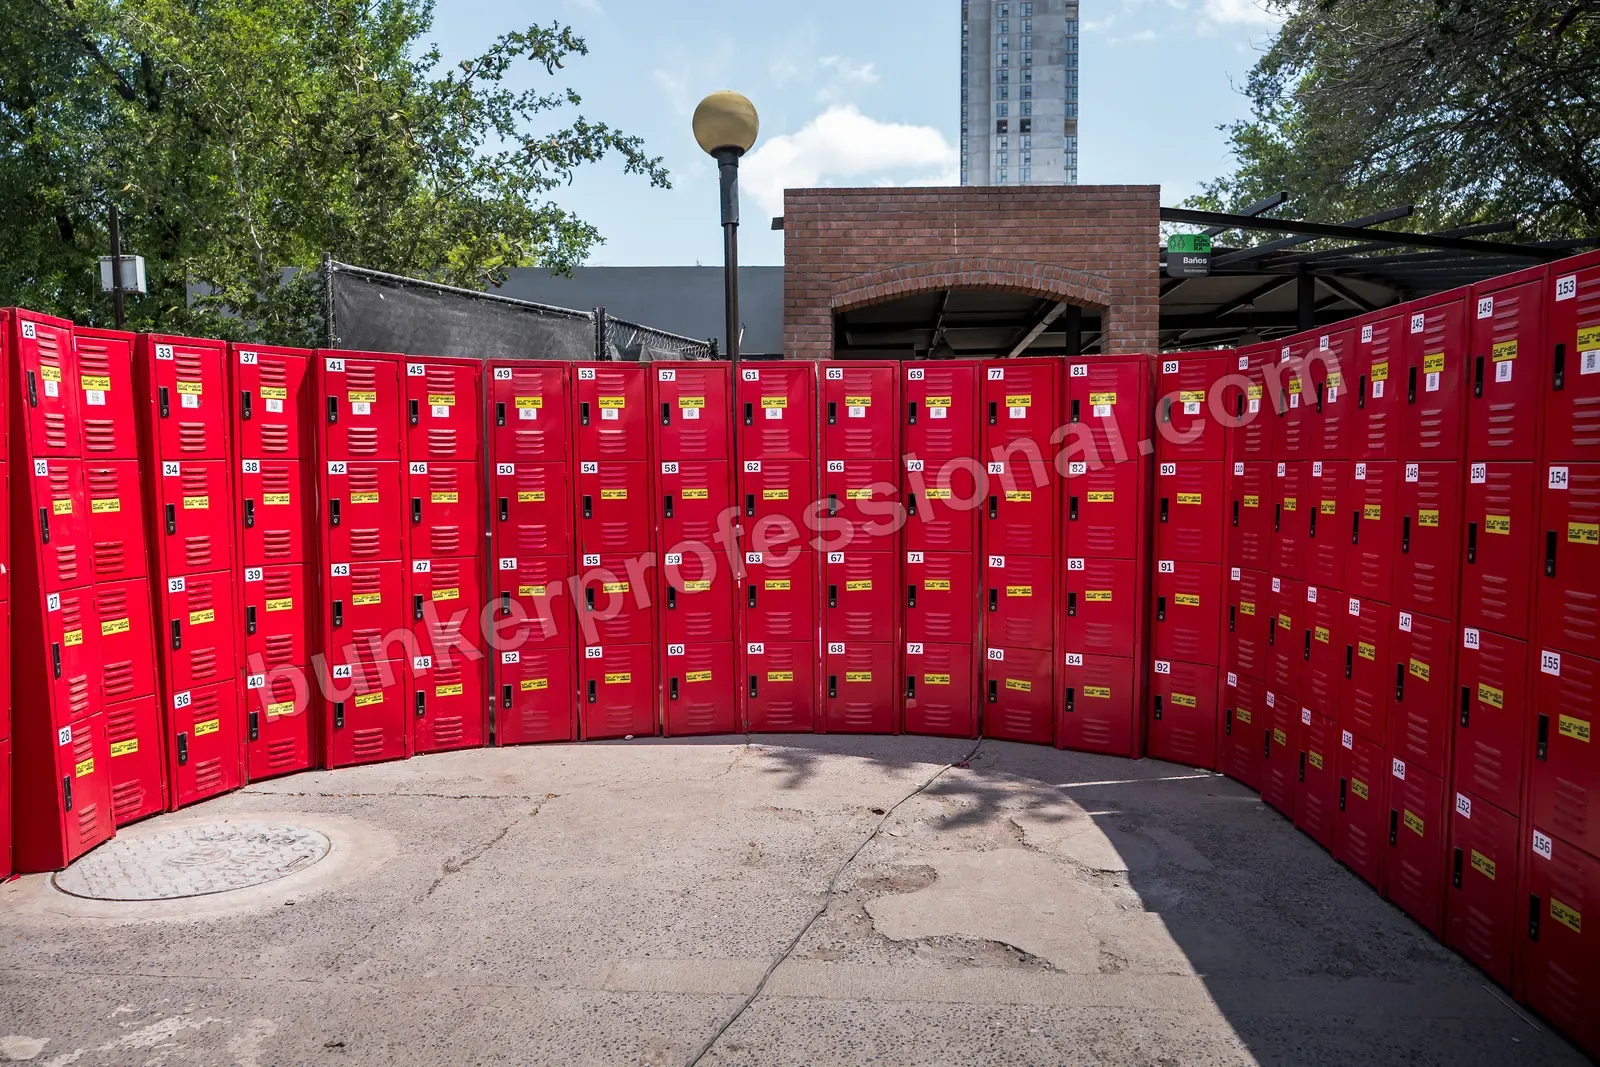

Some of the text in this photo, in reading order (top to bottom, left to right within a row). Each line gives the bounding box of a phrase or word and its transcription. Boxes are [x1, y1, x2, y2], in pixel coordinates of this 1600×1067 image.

[1183, 256, 1208, 264] Baños
[1557, 279, 1575, 296] 153
[1478, 300, 1492, 315] 149
[1412, 317, 1423, 330] 145
[24, 324, 34, 337] 25
[1362, 329, 1371, 340] 133
[158, 347, 171, 359] 33
[243, 352, 255, 363] 37
[329, 361, 343, 371] 41
[409, 365, 423, 375] 45
[1073, 366, 1085, 376] 81
[1164, 362, 1177, 373] 89
[496, 369, 510, 379] 49
[581, 370, 593, 379] 53
[662, 371, 673, 380] 57
[745, 371, 757, 380] 61
[828, 370, 841, 379] 65
[910, 370, 923, 379] 69
[990, 370, 1001, 379] 77
[36, 462, 46, 474] 26
[165, 464, 178, 475] 34
[245, 462, 258, 472] 38
[331, 463, 345, 473] 42
[411, 464, 426, 473] 46
[499, 465, 513, 474] 50
[583, 463, 596, 473] 54
[664, 463, 677, 473] 58
[746, 462, 759, 471] 62
[829, 462, 843, 471] 66
[910, 461, 922, 470] 70
[990, 464, 1002, 473] 78
[1072, 463, 1084, 473] 82
[1161, 464, 1175, 474] 90
[1356, 466, 1365, 476] 134
[1406, 467, 1418, 478] 146
[1471, 466, 1485, 479] 150
[1550, 471, 1567, 484] 154
[586, 556, 598, 565] 55
[668, 555, 680, 564] 59
[748, 554, 761, 563] 63
[830, 553, 842, 562] 67
[910, 553, 921, 562] 71
[991, 557, 1003, 567] 79
[415, 562, 428, 571] 47
[502, 559, 514, 569] 51
[1070, 560, 1083, 569] 83
[1161, 562, 1172, 572] 91
[247, 569, 261, 580] 39
[333, 565, 348, 575] 43
[171, 579, 183, 591] 35
[49, 596, 58, 609] 27
[1349, 601, 1359, 612] 135
[1400, 615, 1411, 628] 147
[1465, 632, 1478, 645] 151
[588, 648, 601, 657] 56
[669, 645, 683, 655] 60
[749, 644, 762, 653] 64
[830, 644, 843, 653] 68
[909, 644, 921, 653] 72
[505, 653, 517, 663] 52
[989, 650, 1002, 659] 80
[1068, 655, 1081, 664] 84
[416, 658, 430, 667] 48
[1156, 662, 1168, 673] 92
[1542, 655, 1559, 671] 155
[335, 667, 350, 677] 44
[249, 676, 263, 687] 40
[176, 694, 189, 707] 36
[60, 729, 70, 743] 28
[1393, 761, 1405, 777] 148
[1457, 797, 1470, 815] 152
[1534, 835, 1551, 854] 156
